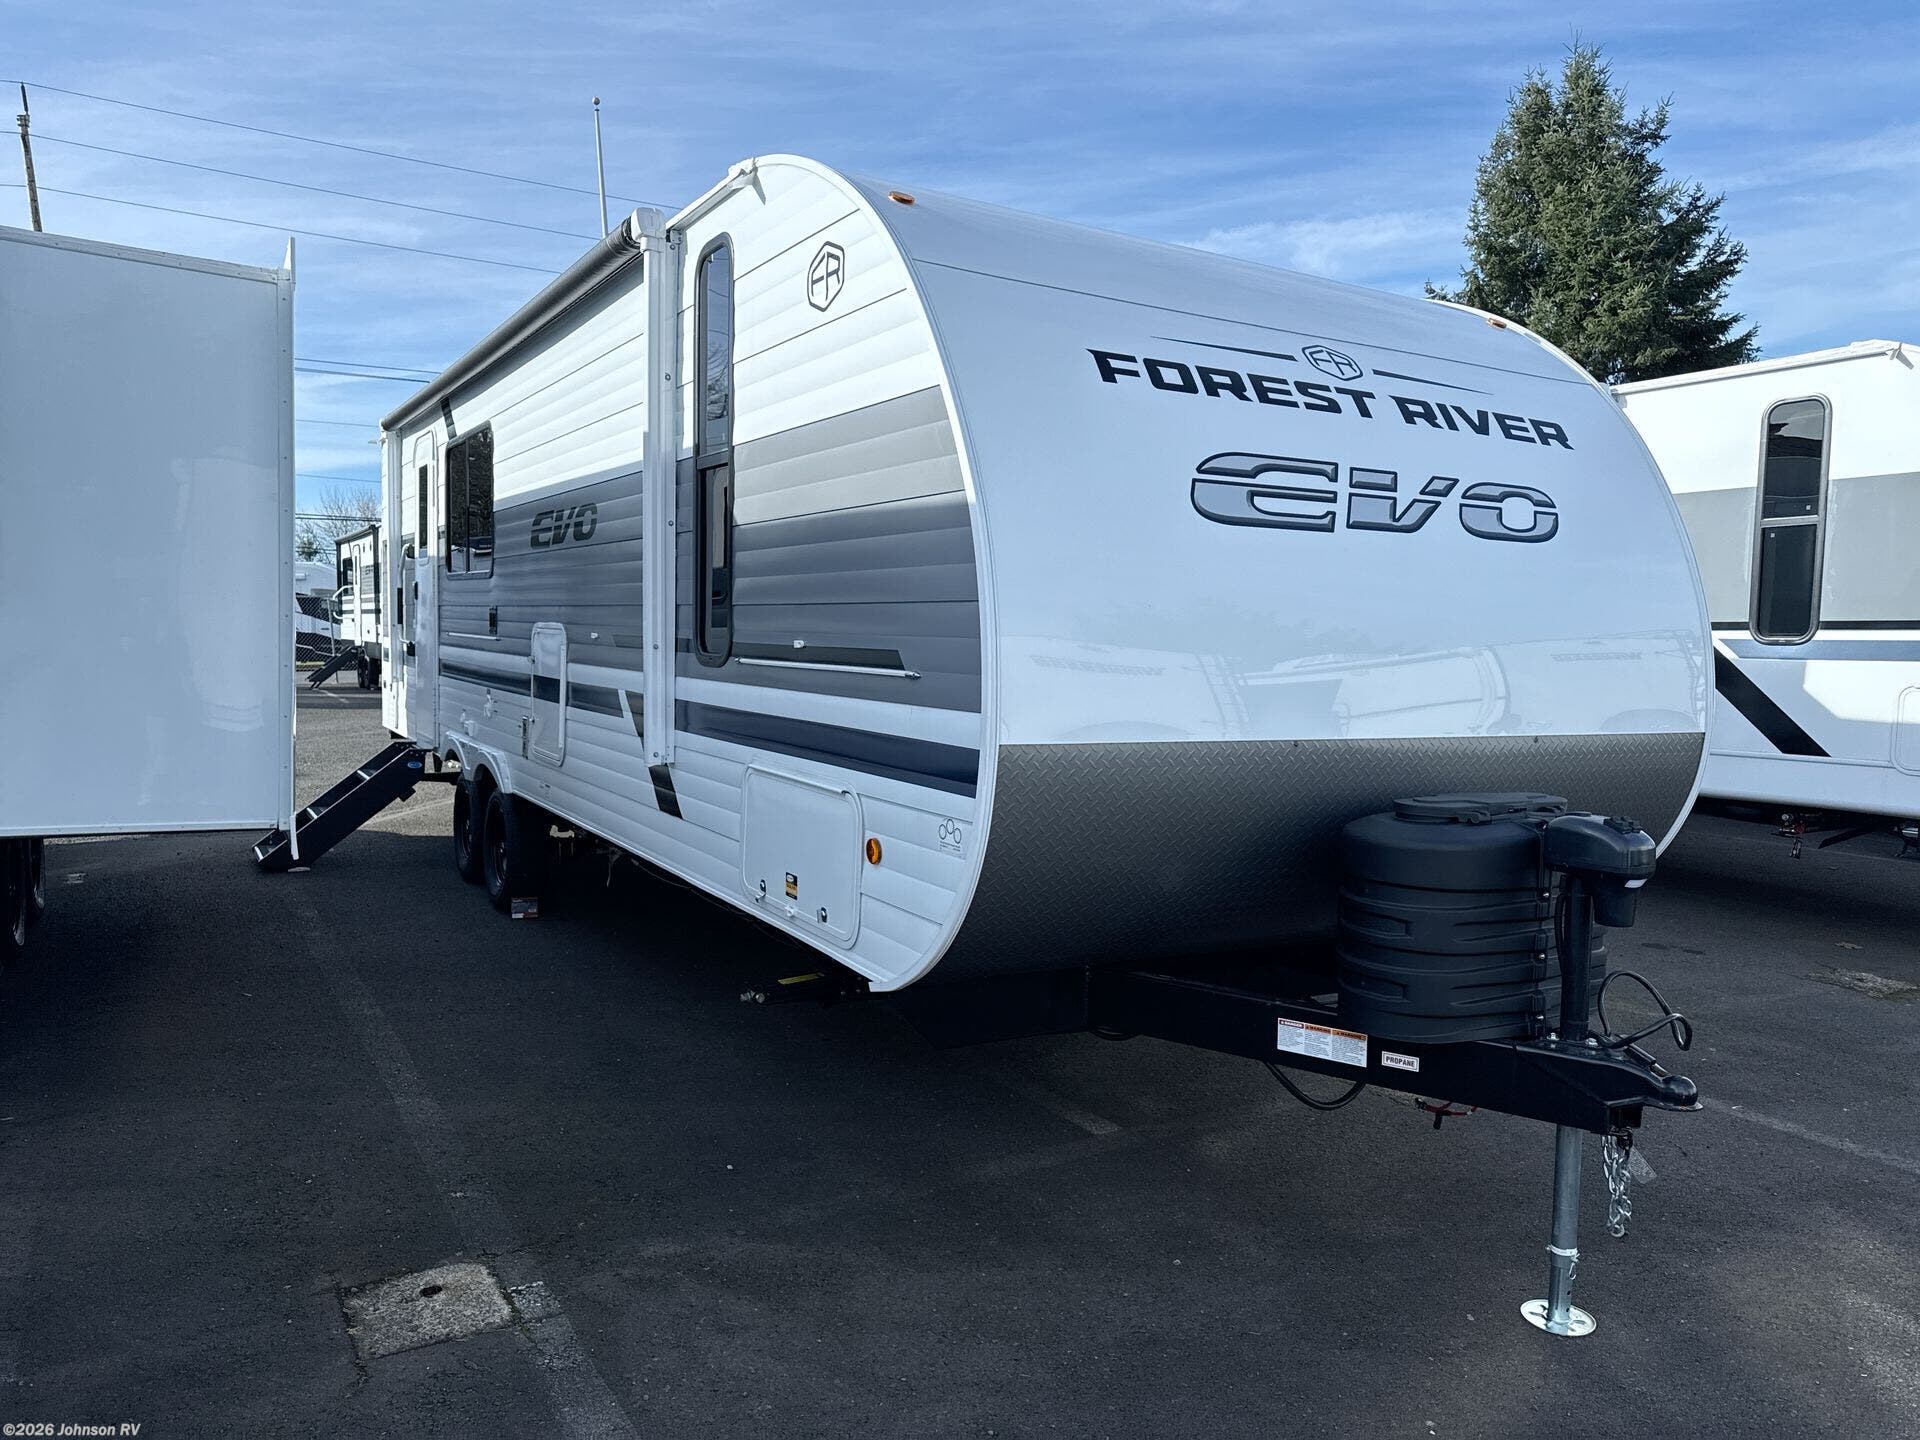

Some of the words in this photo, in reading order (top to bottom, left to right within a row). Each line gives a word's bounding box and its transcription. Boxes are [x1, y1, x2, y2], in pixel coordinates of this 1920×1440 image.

[1086, 348, 1375, 419] FOREST
[1388, 394, 1575, 451] RIVER
[530, 502, 598, 549] EVO
[1190, 451, 1559, 544] EVO
[1385, 1056, 1415, 1068] PROPANE
